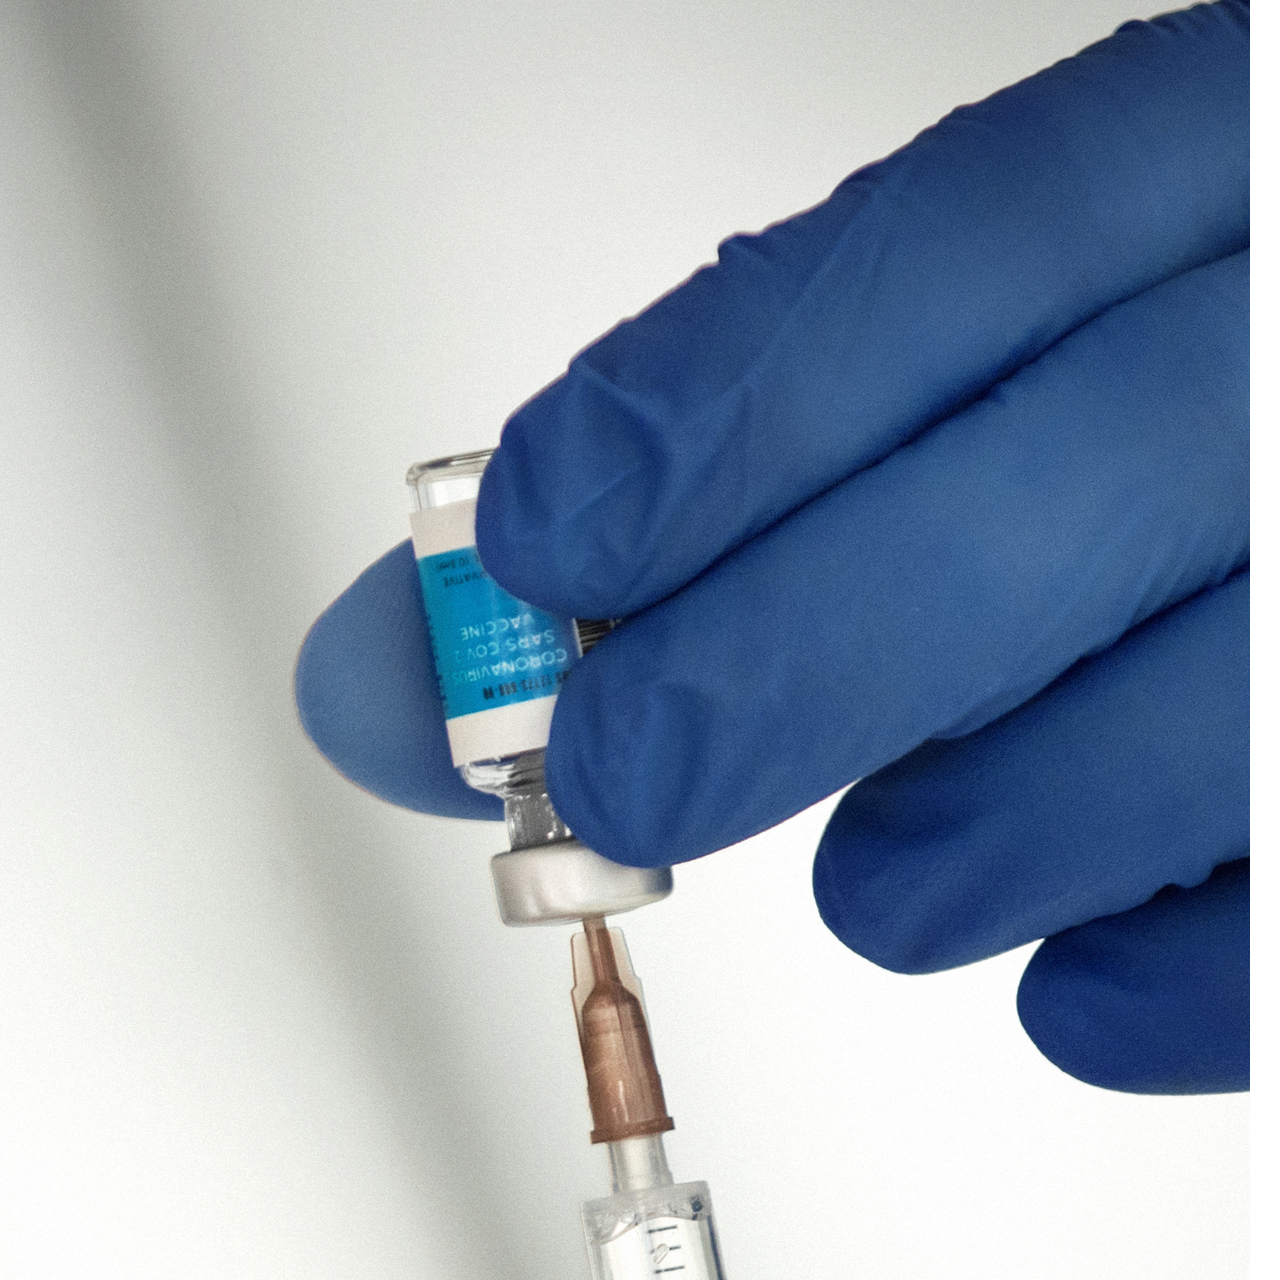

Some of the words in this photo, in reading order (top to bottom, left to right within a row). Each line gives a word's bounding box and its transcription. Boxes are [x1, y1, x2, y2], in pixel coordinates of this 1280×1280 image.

[460, 612, 534, 641] VACCINE
[504, 629, 555, 652] SARS
[451, 647, 568, 686] CORONAVIRUS
